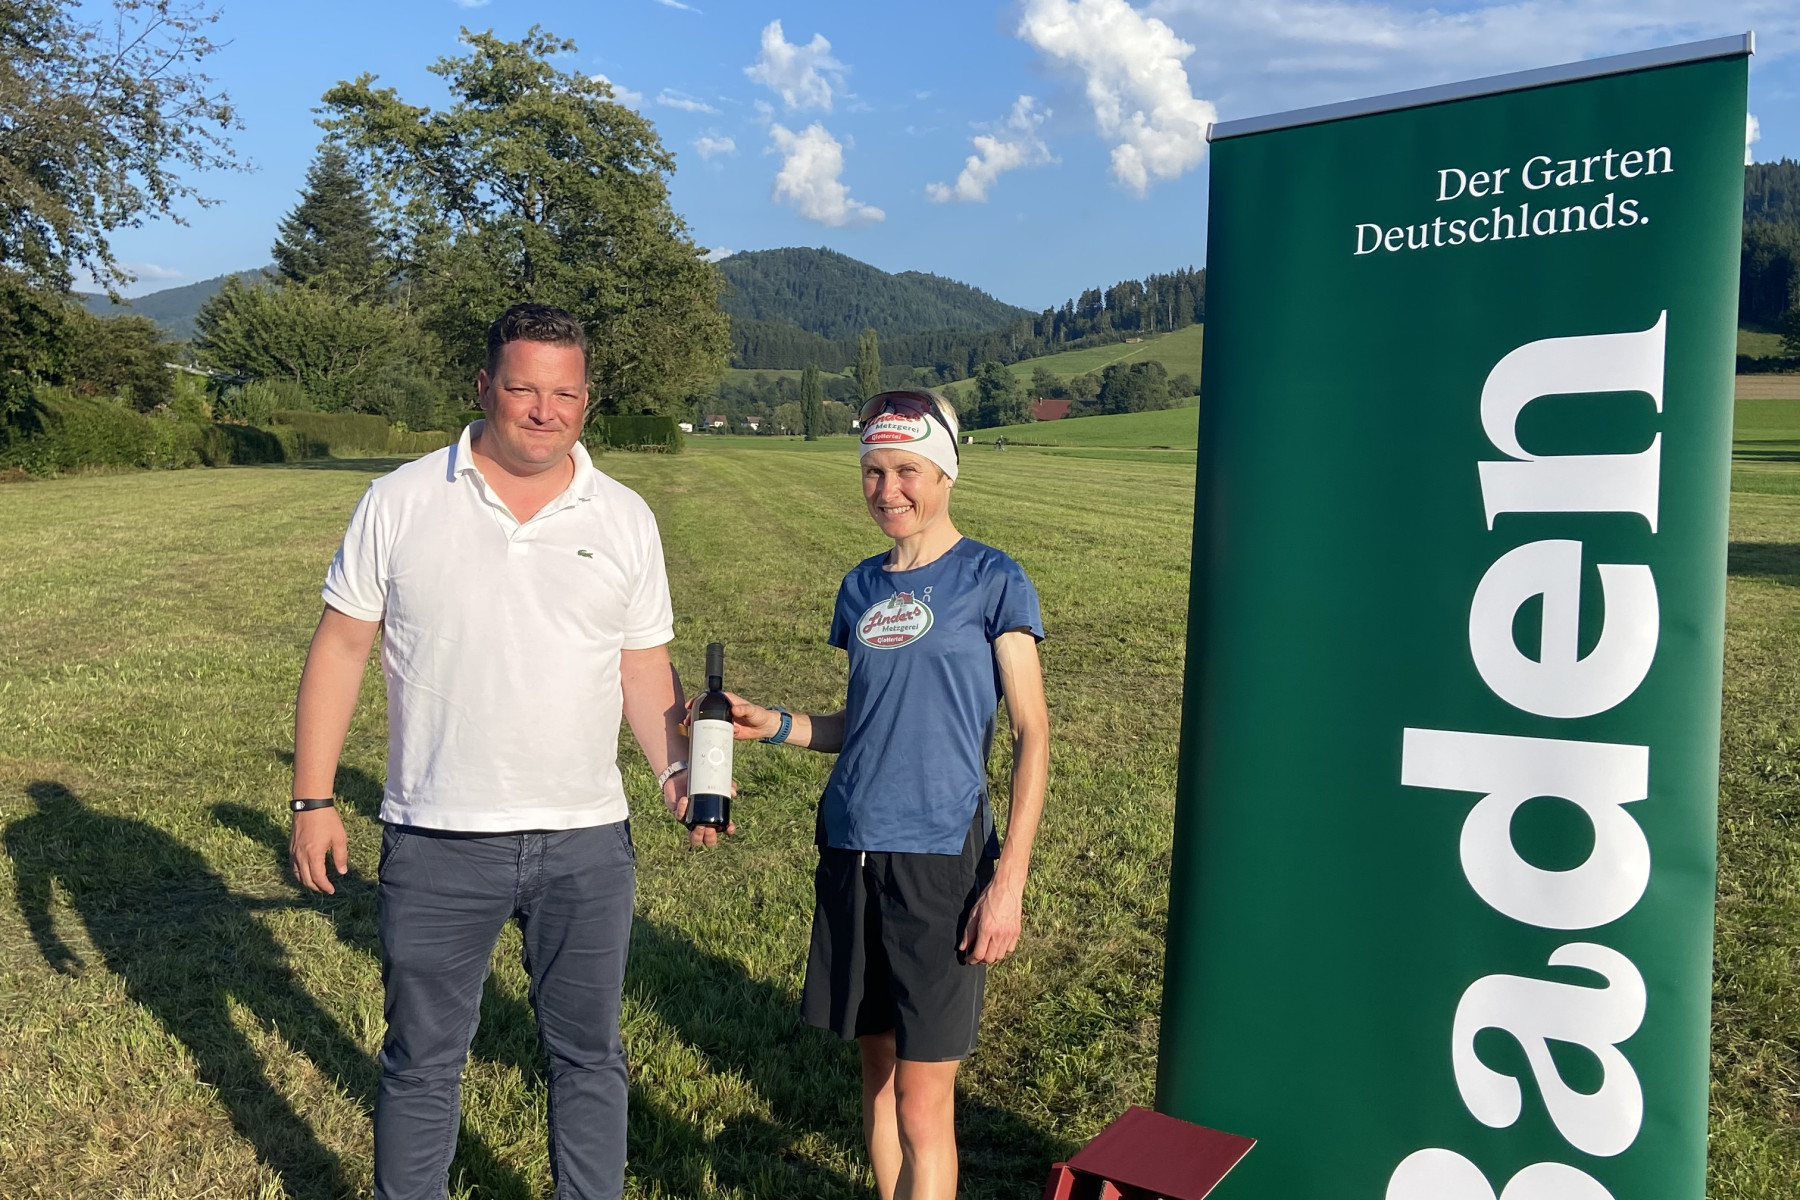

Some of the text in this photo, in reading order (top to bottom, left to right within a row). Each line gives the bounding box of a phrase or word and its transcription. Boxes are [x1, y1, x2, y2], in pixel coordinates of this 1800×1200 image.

[1436, 146, 1674, 202] Der Garten
[1353, 192, 1650, 255] Deutschlands.
[875, 423, 919, 433] Metzgerei
[882, 624, 919, 632] Metzgerei
[1385, 309, 1668, 1200] aden
